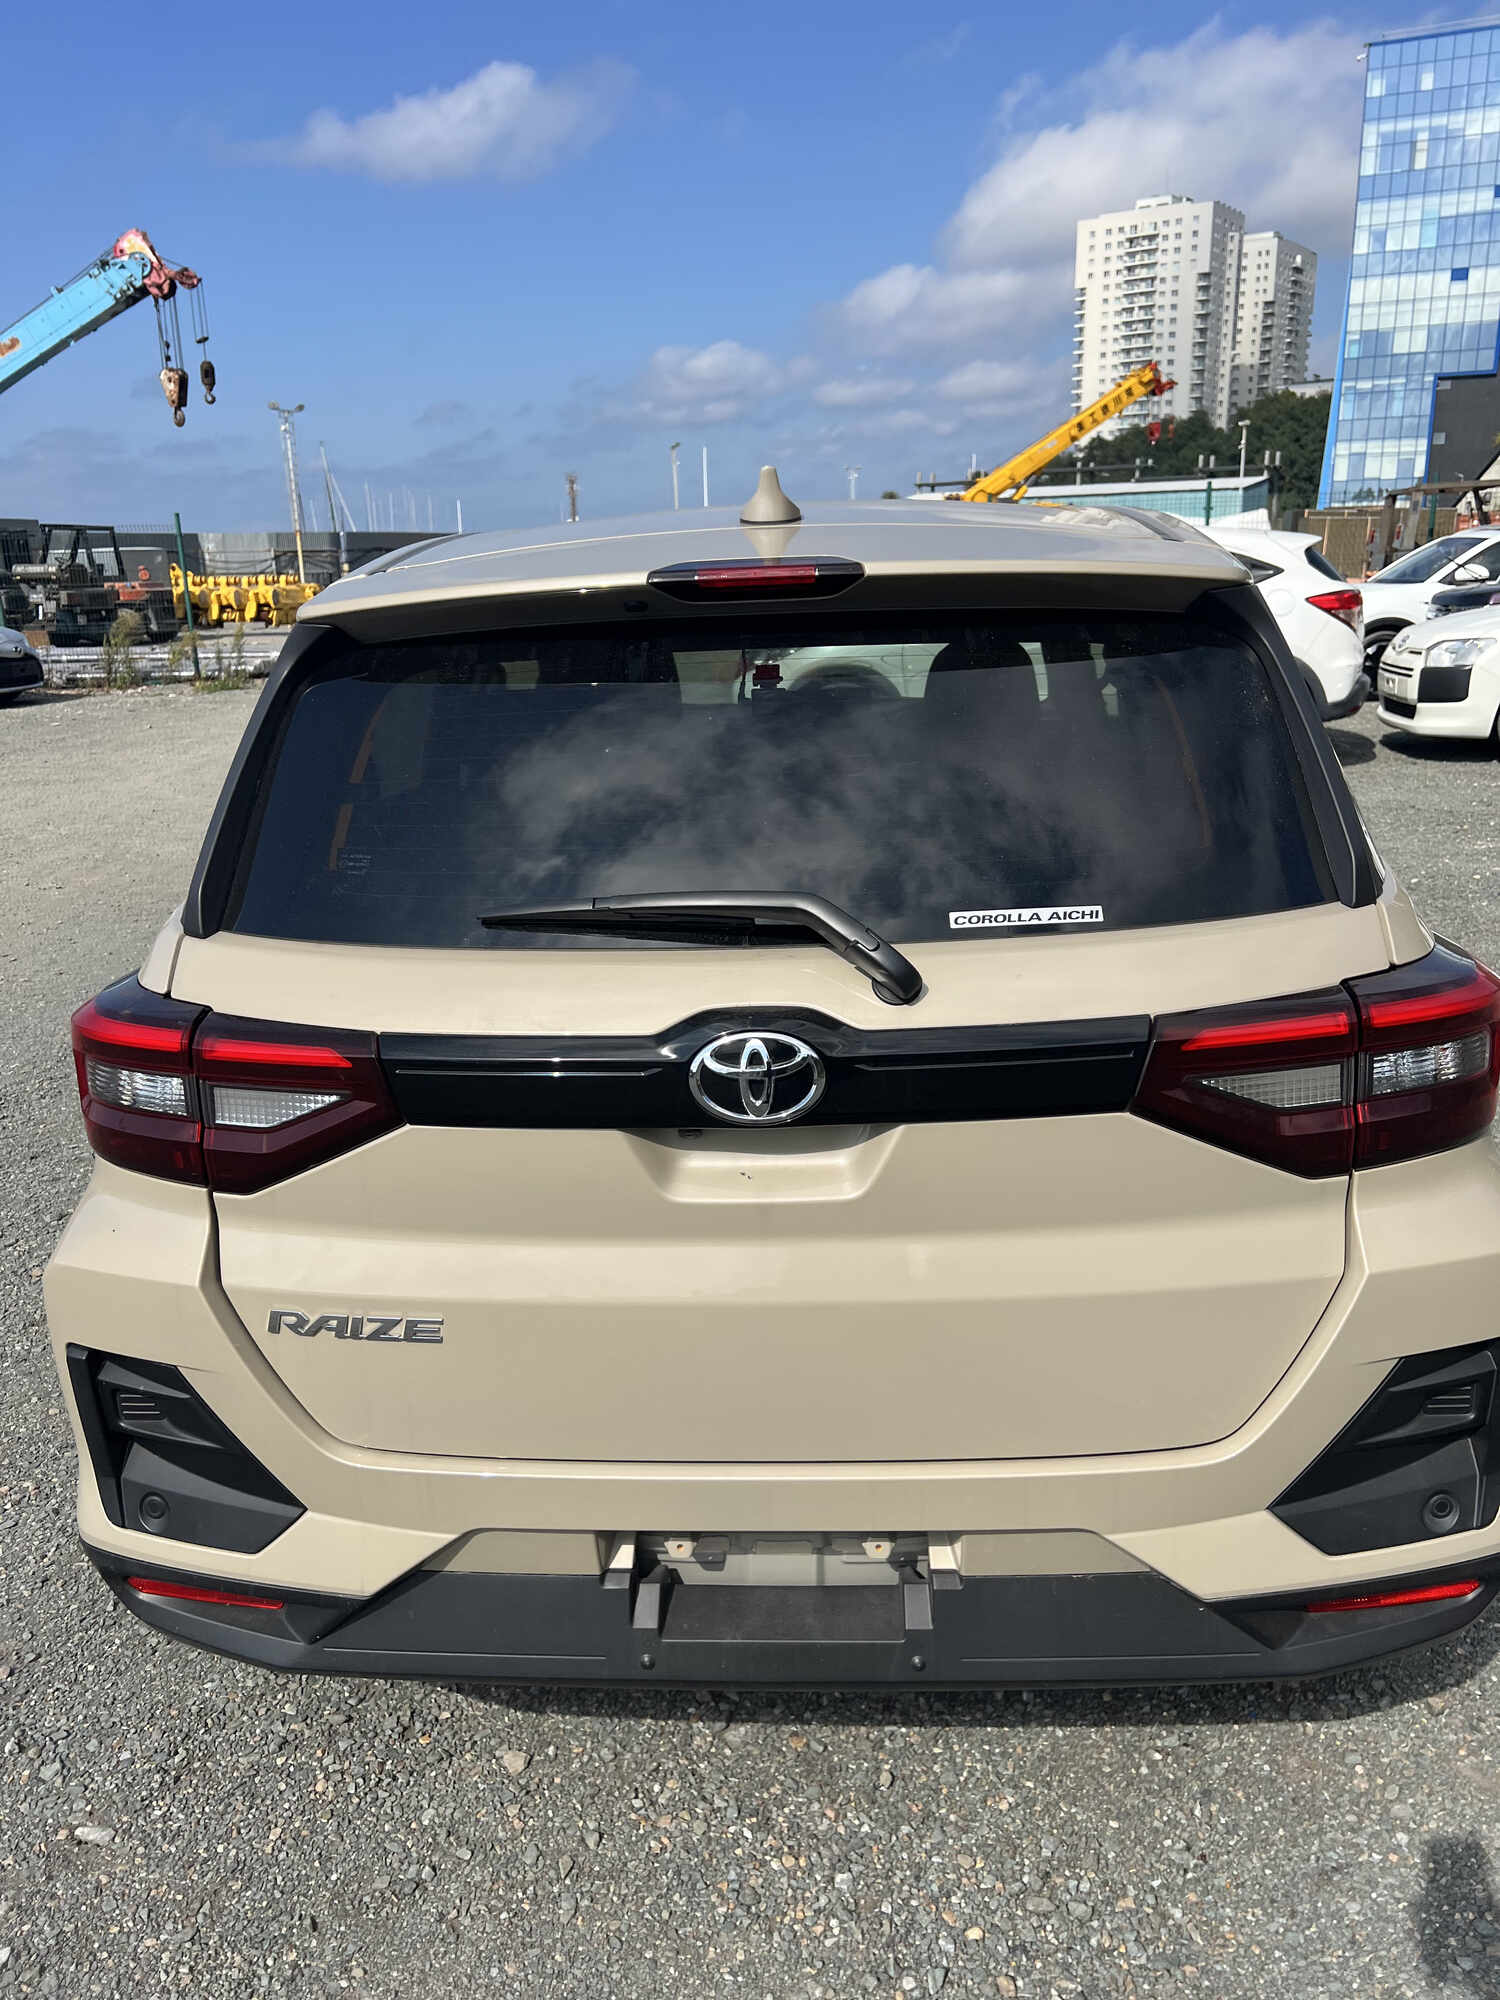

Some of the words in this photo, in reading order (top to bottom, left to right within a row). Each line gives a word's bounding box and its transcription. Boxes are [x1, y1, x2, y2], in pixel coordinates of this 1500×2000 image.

[954, 912, 1042, 926] COROLLA
[1048, 910, 1100, 921] AICHI
[267, 1309, 444, 1344] RAIZE
